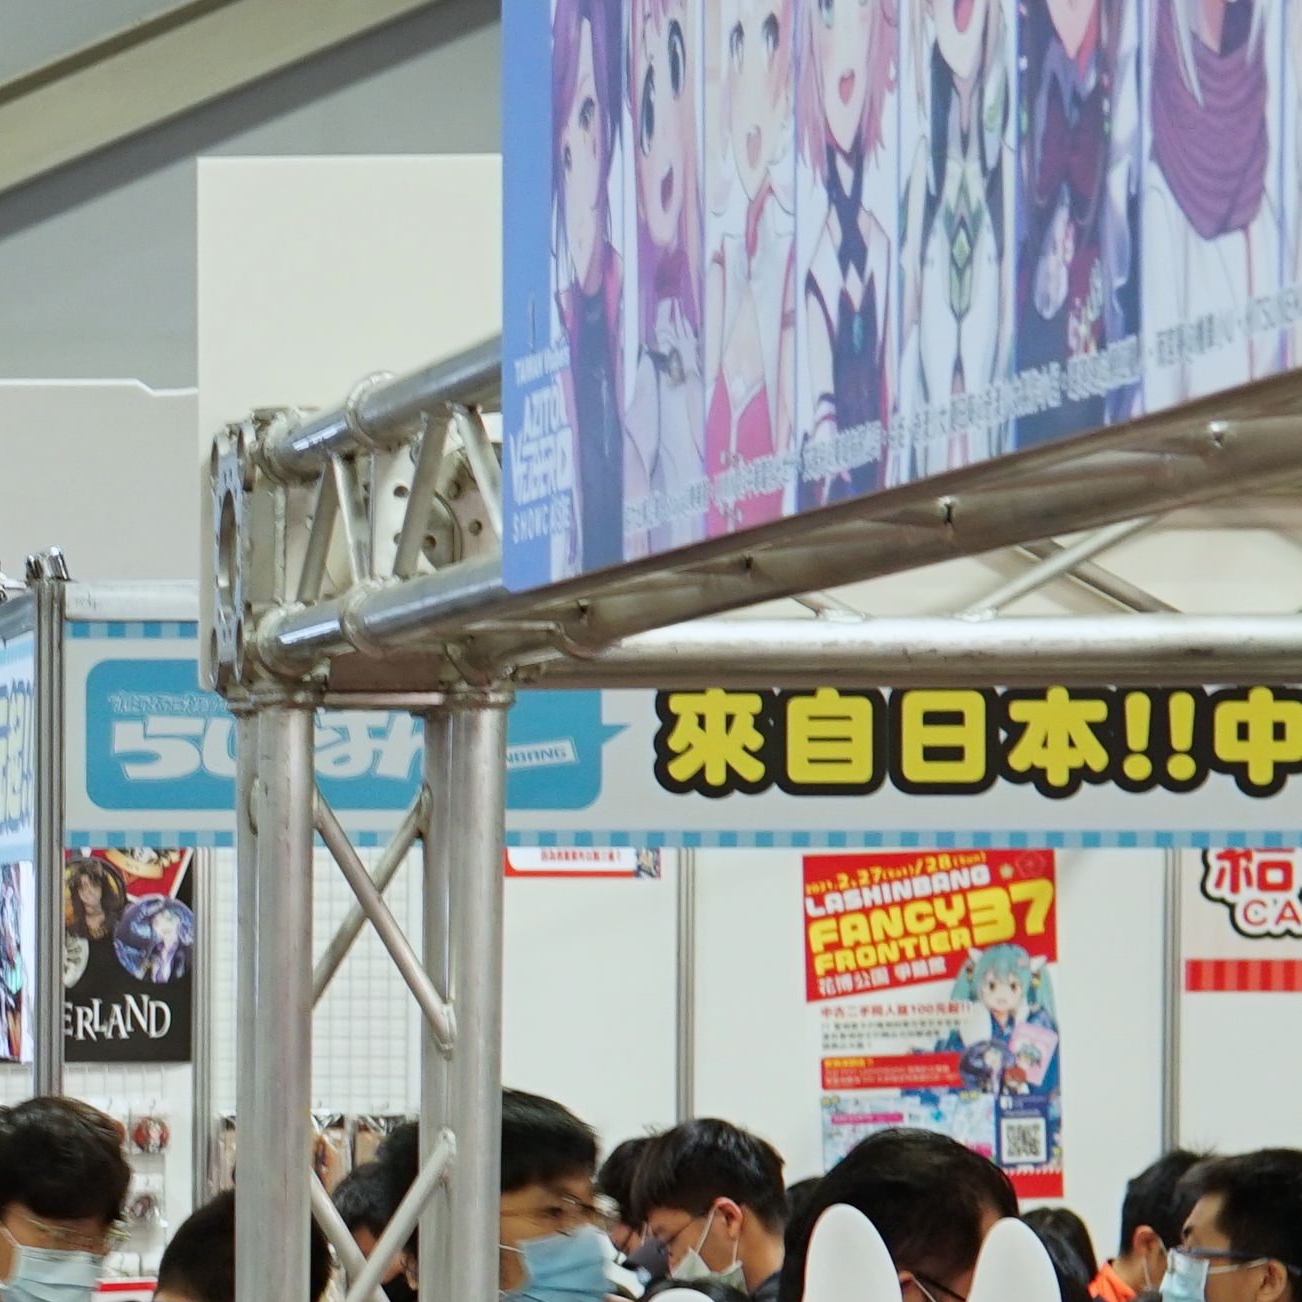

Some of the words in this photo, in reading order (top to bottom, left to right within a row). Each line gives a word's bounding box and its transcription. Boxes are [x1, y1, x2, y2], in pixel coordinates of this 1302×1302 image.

[662, 686, 1302, 790] 來自日本!!中
[808, 894, 967, 953] FANCY
[967, 878, 1054, 945] 37
[814, 926, 973, 976] FRONTIER
